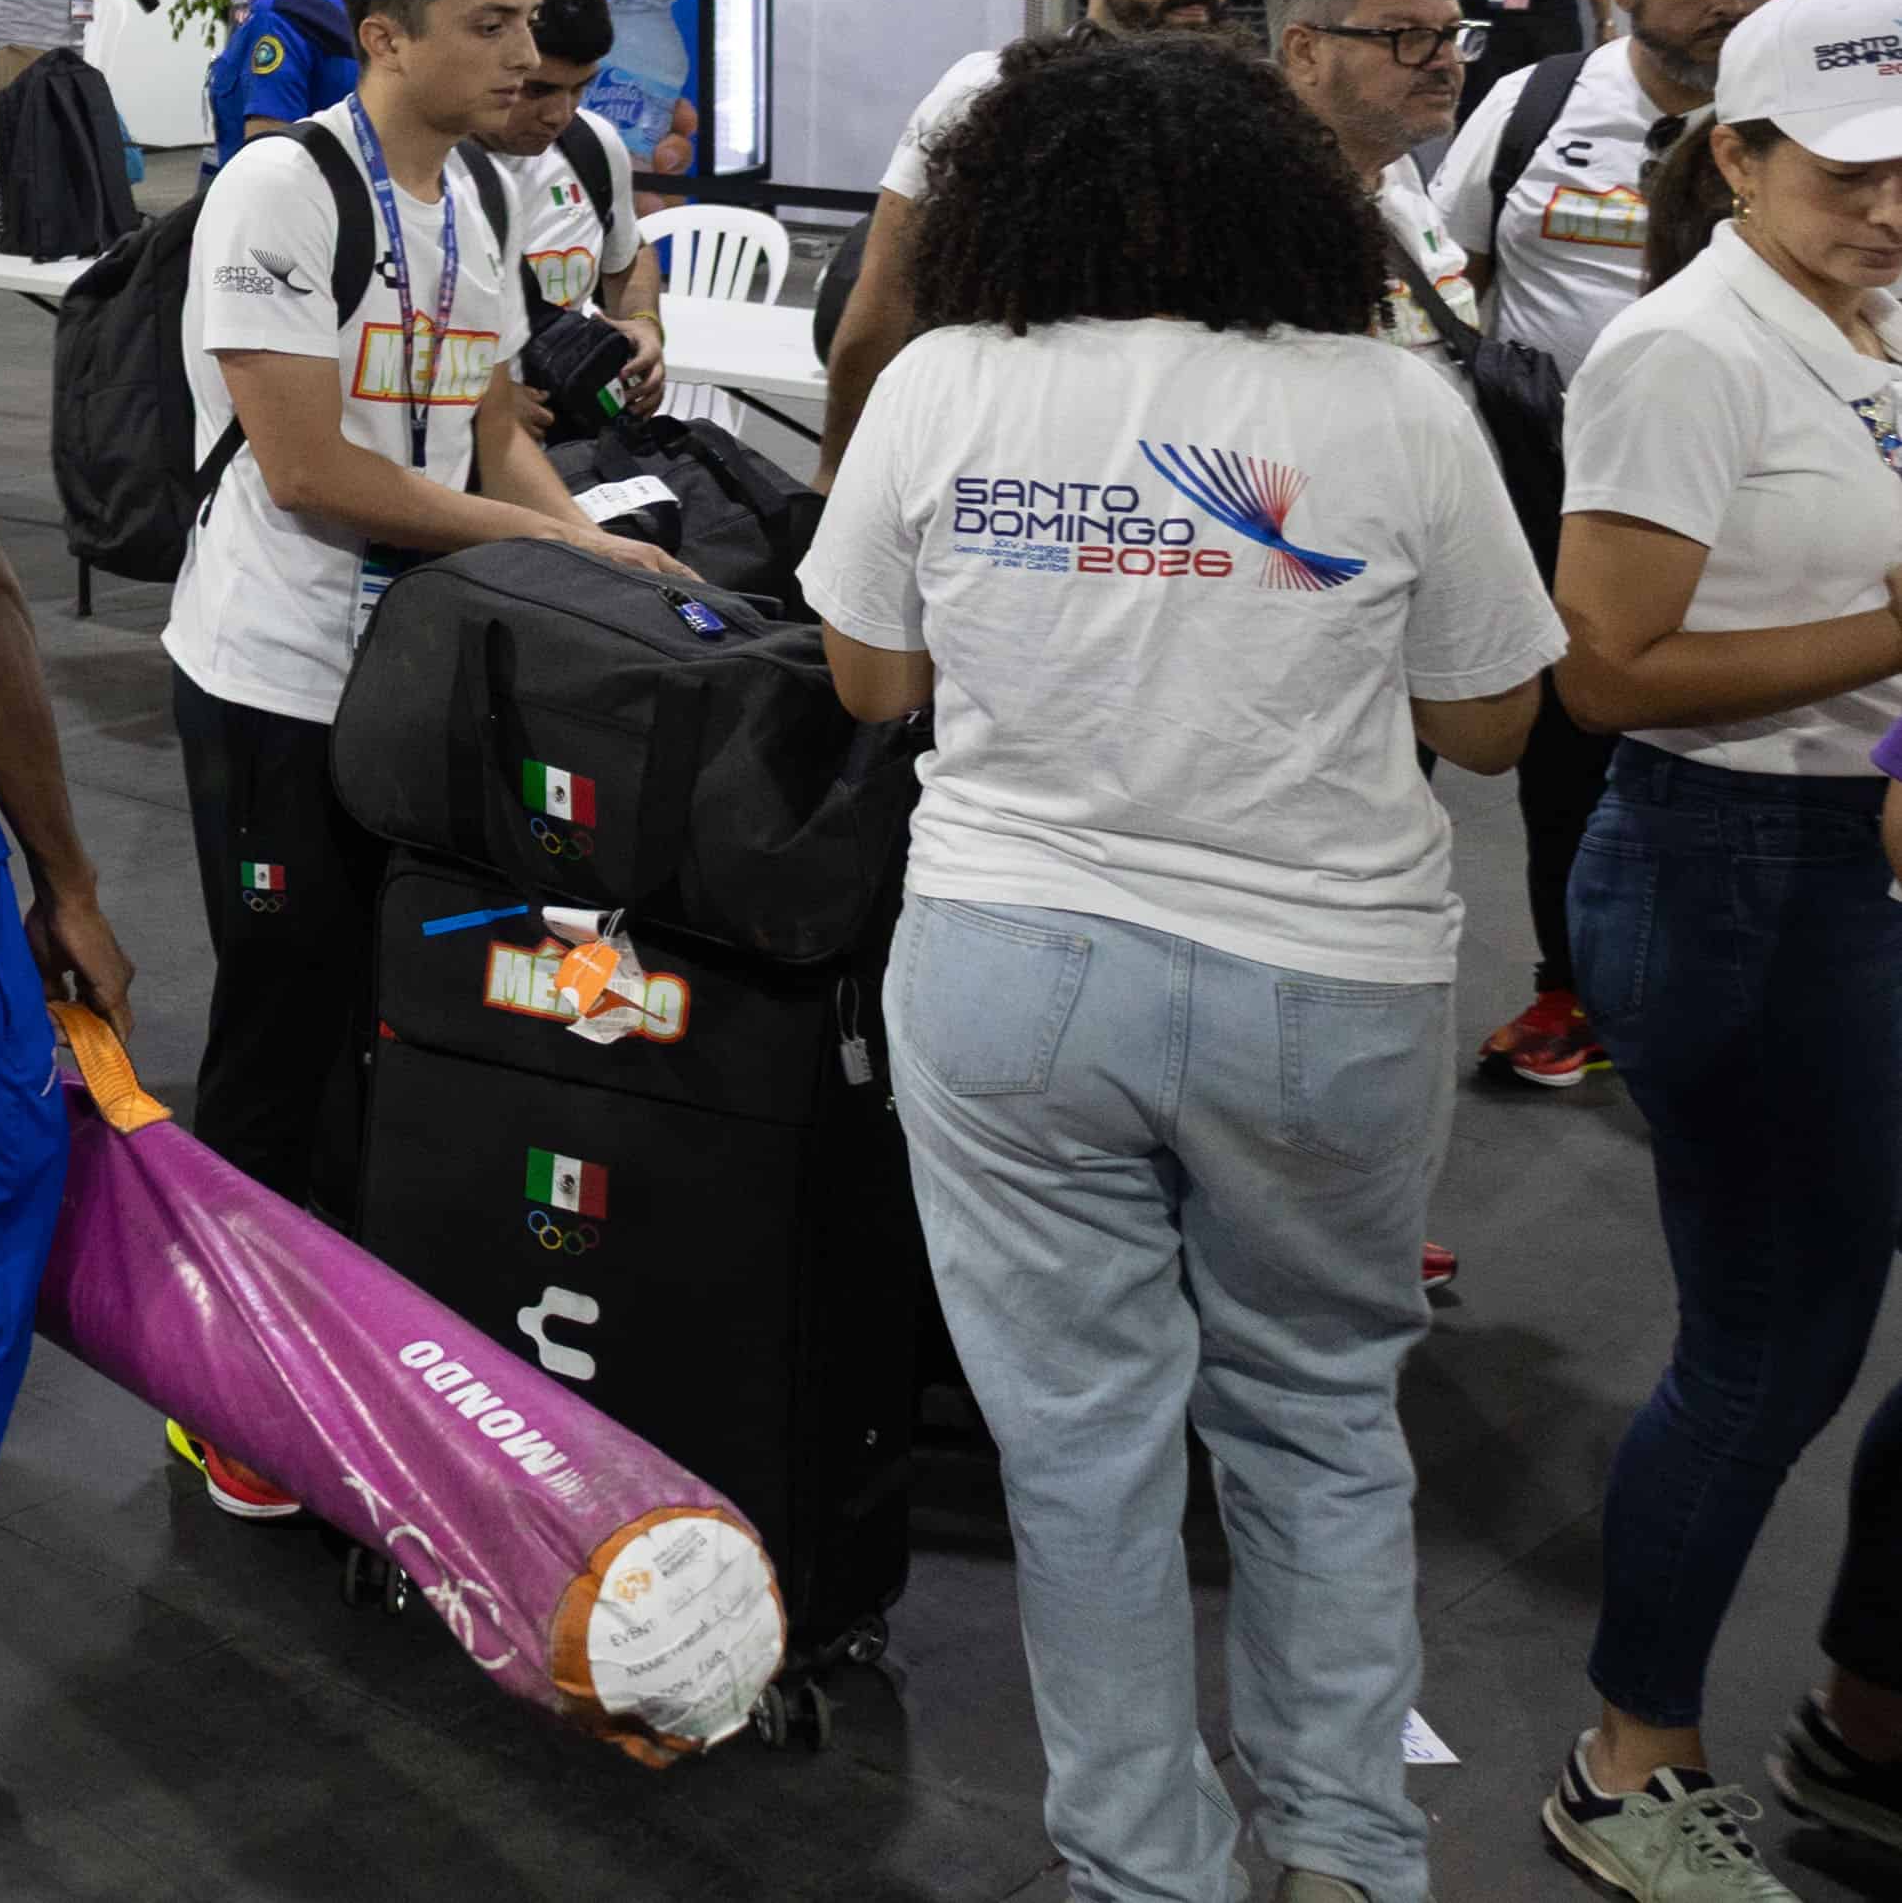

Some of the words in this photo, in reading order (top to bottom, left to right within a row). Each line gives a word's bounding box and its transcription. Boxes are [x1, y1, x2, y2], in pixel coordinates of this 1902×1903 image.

[1814, 34, 1900, 59] SANTO
[955, 477, 1140, 513] SANTO
[953, 506, 1195, 546] DOMINGO
[1077, 545, 1234, 577] 2026
[486, 940, 689, 1040] MÉO
[399, 1340, 569, 1476] MONDO
